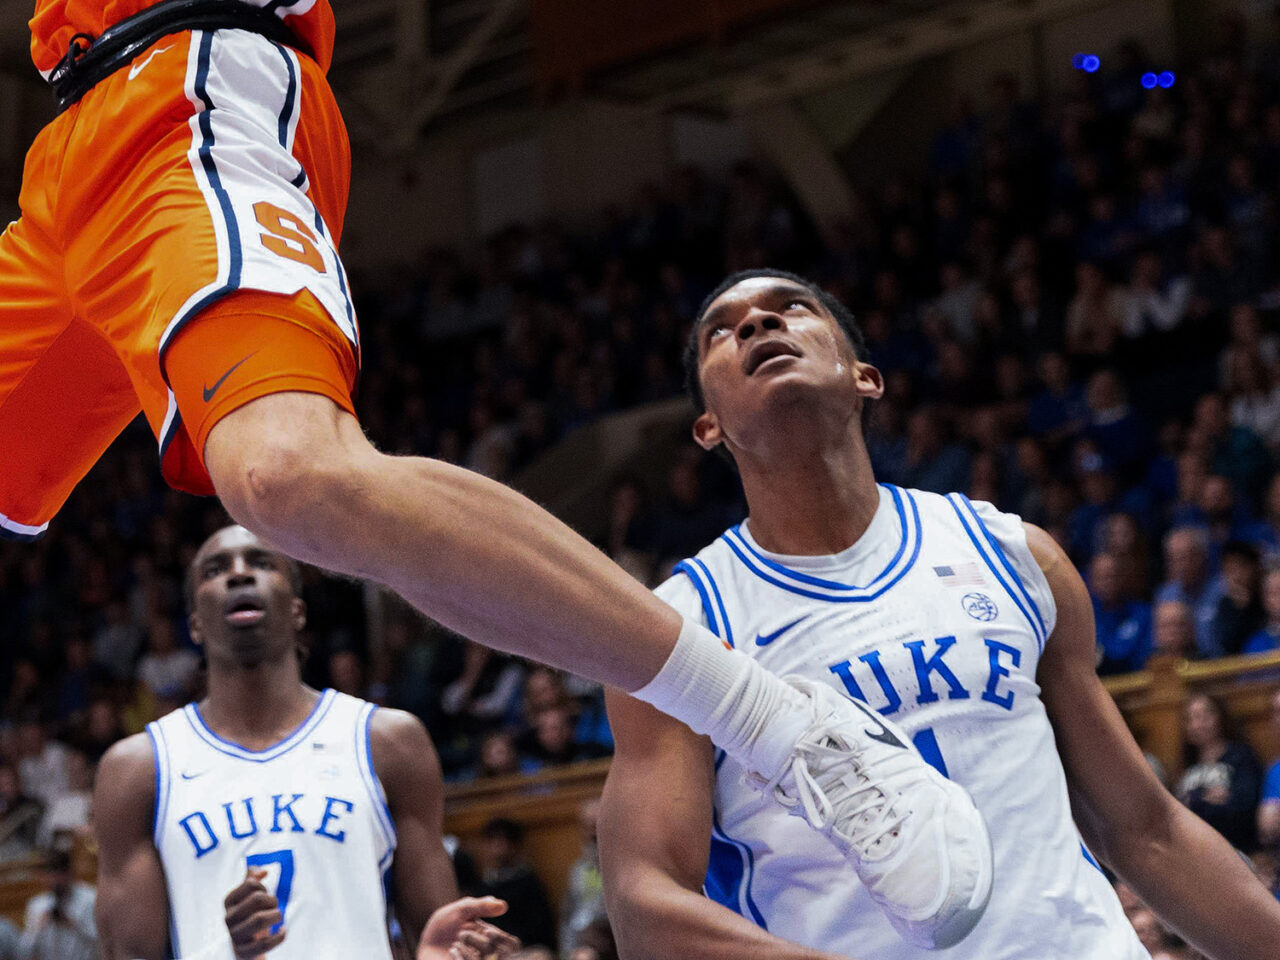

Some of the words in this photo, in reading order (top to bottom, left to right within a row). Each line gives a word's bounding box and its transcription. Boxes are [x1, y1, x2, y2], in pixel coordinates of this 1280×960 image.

[252, 201, 327, 274] S
[828, 635, 1022, 716] UKE
[179, 793, 355, 859] DUKE
[246, 849, 295, 935] 7
